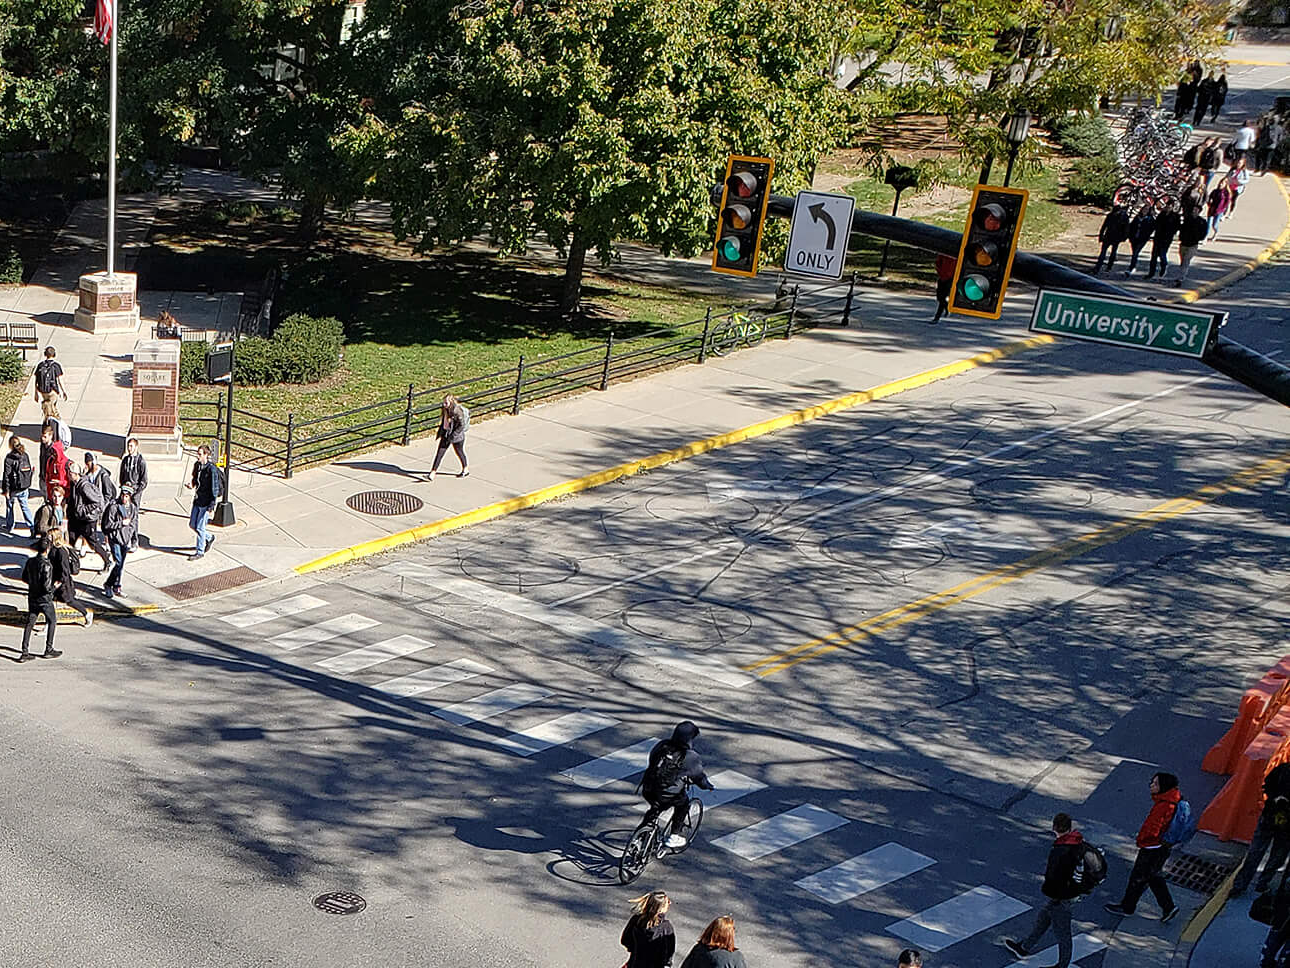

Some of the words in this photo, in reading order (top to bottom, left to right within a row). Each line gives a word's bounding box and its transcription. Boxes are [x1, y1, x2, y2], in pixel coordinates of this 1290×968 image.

[796, 250, 835, 270] ONLY
[1044, 301, 1163, 346] University
[1171, 321, 1199, 348] St
